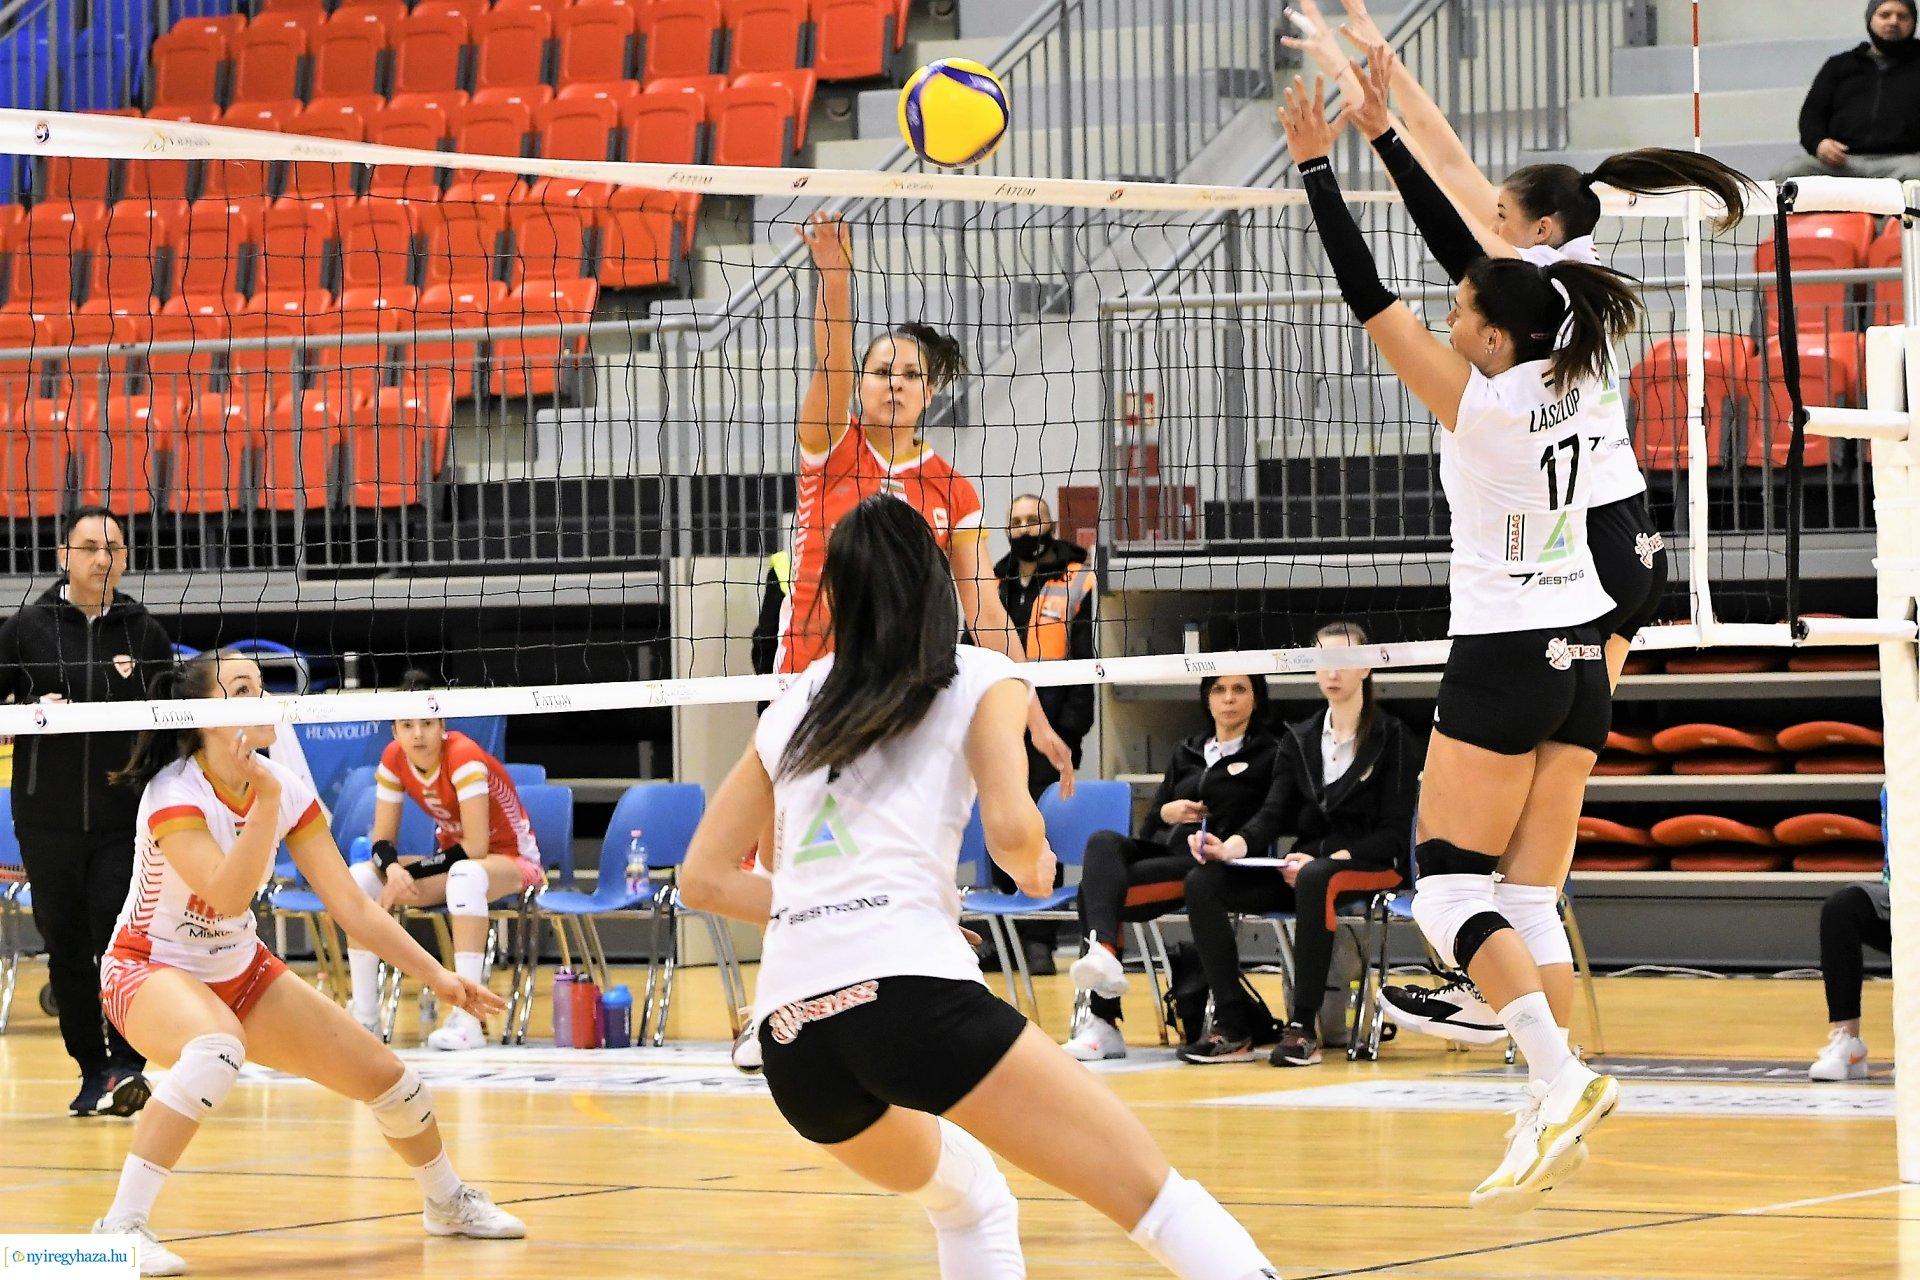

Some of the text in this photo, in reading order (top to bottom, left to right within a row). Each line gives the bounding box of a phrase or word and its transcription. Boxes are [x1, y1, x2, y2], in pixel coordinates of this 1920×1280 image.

[1540, 433, 1580, 511] 17
[1510, 514, 1521, 561] STRABAG
[1183, 658, 1217, 672] FATUM
[532, 690, 572, 707] FATUM
[151, 706, 195, 724] FATUM
